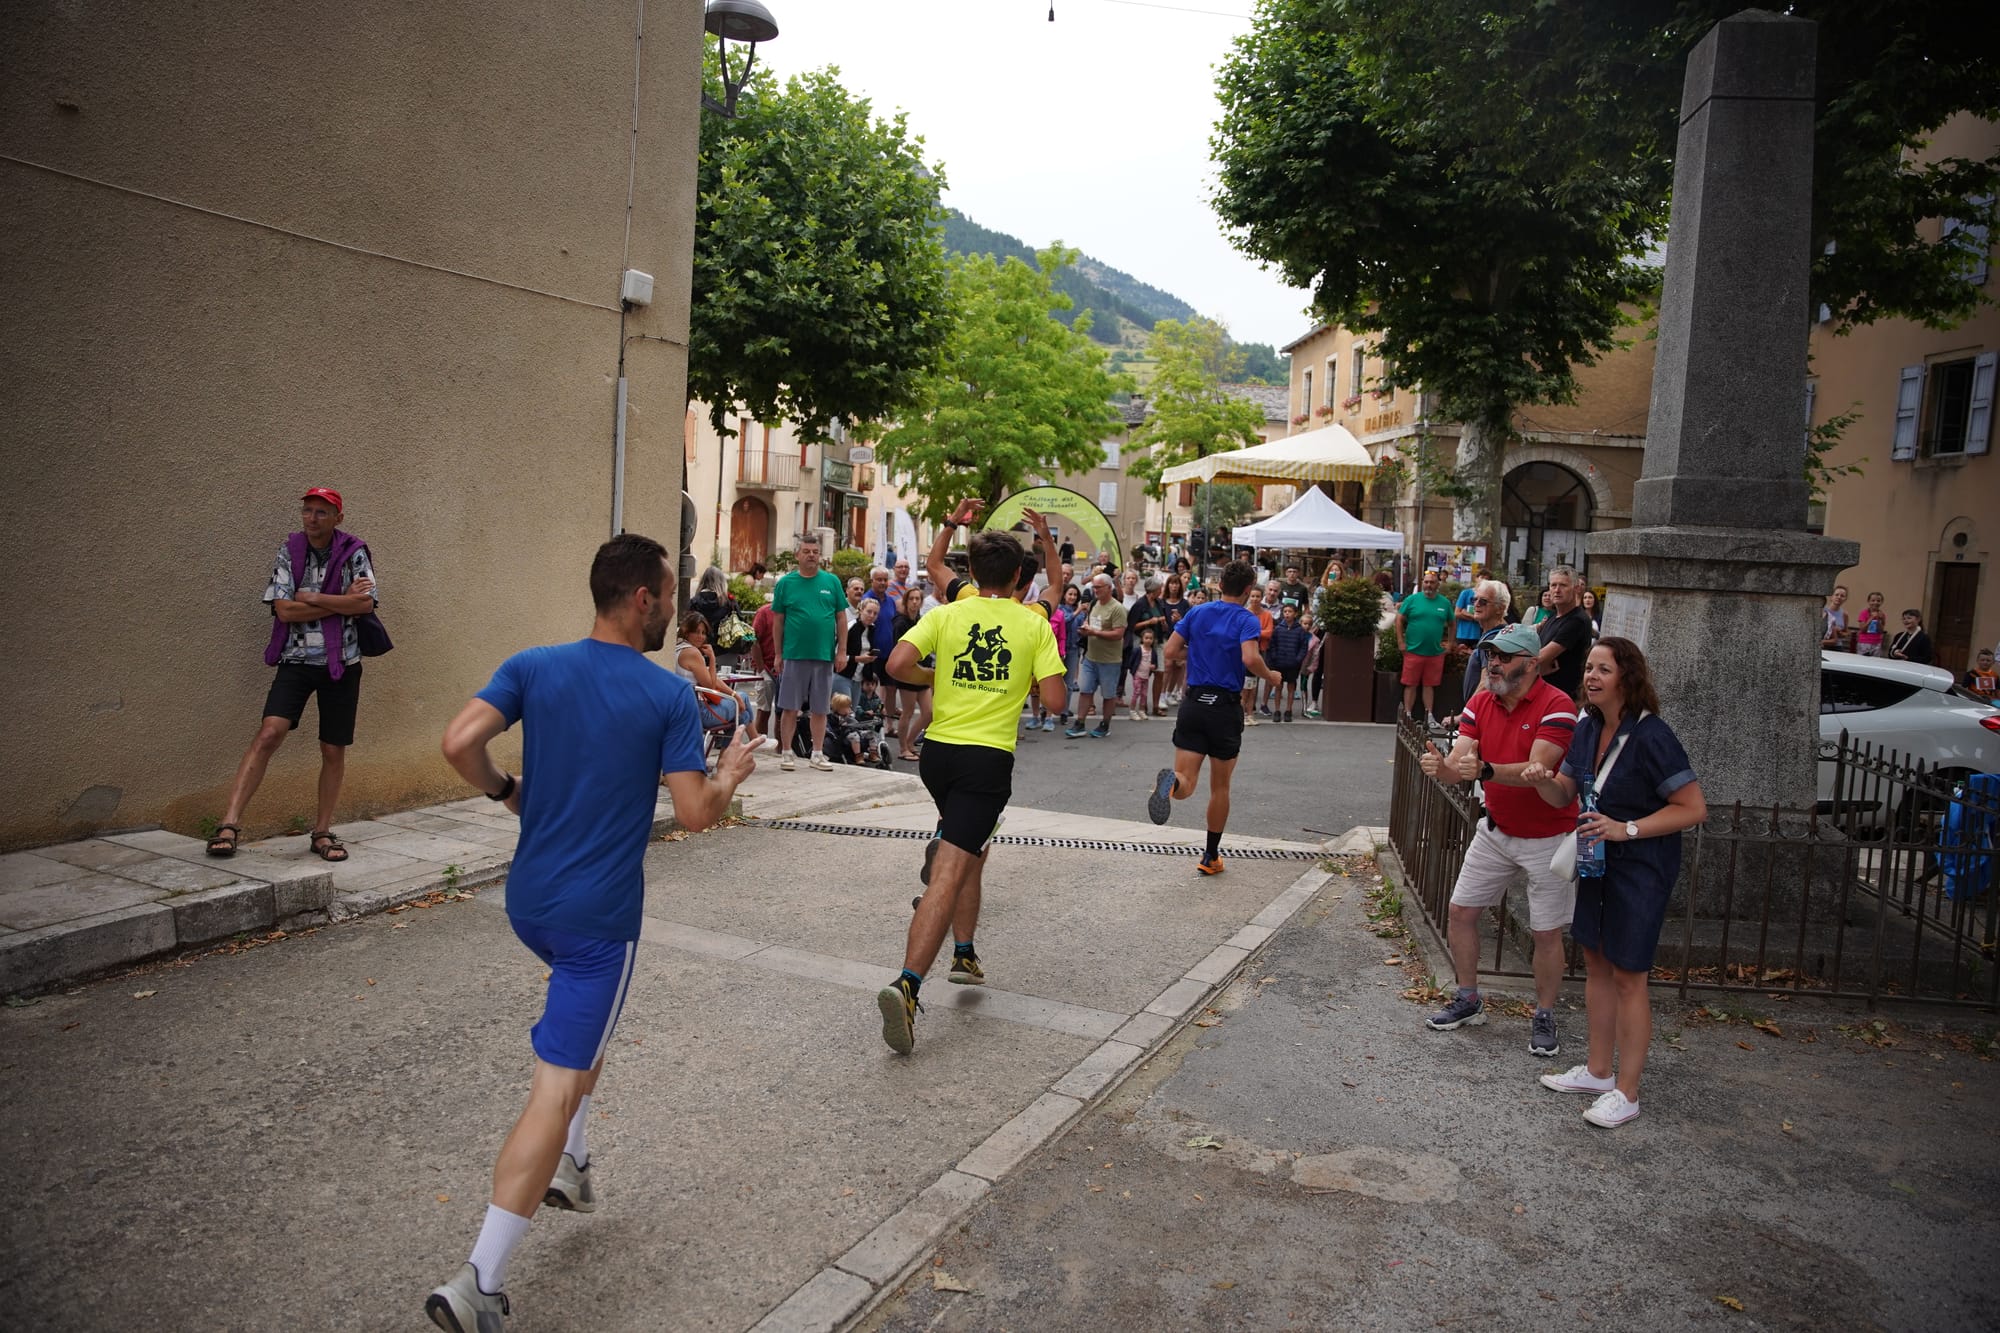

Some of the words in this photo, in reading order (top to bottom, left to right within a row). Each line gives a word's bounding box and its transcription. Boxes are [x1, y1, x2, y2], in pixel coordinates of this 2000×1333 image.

[1364, 410, 1401, 432] MAIRIE
[952, 680, 967, 688] Trail
[978, 683, 1008, 695] Rousses
